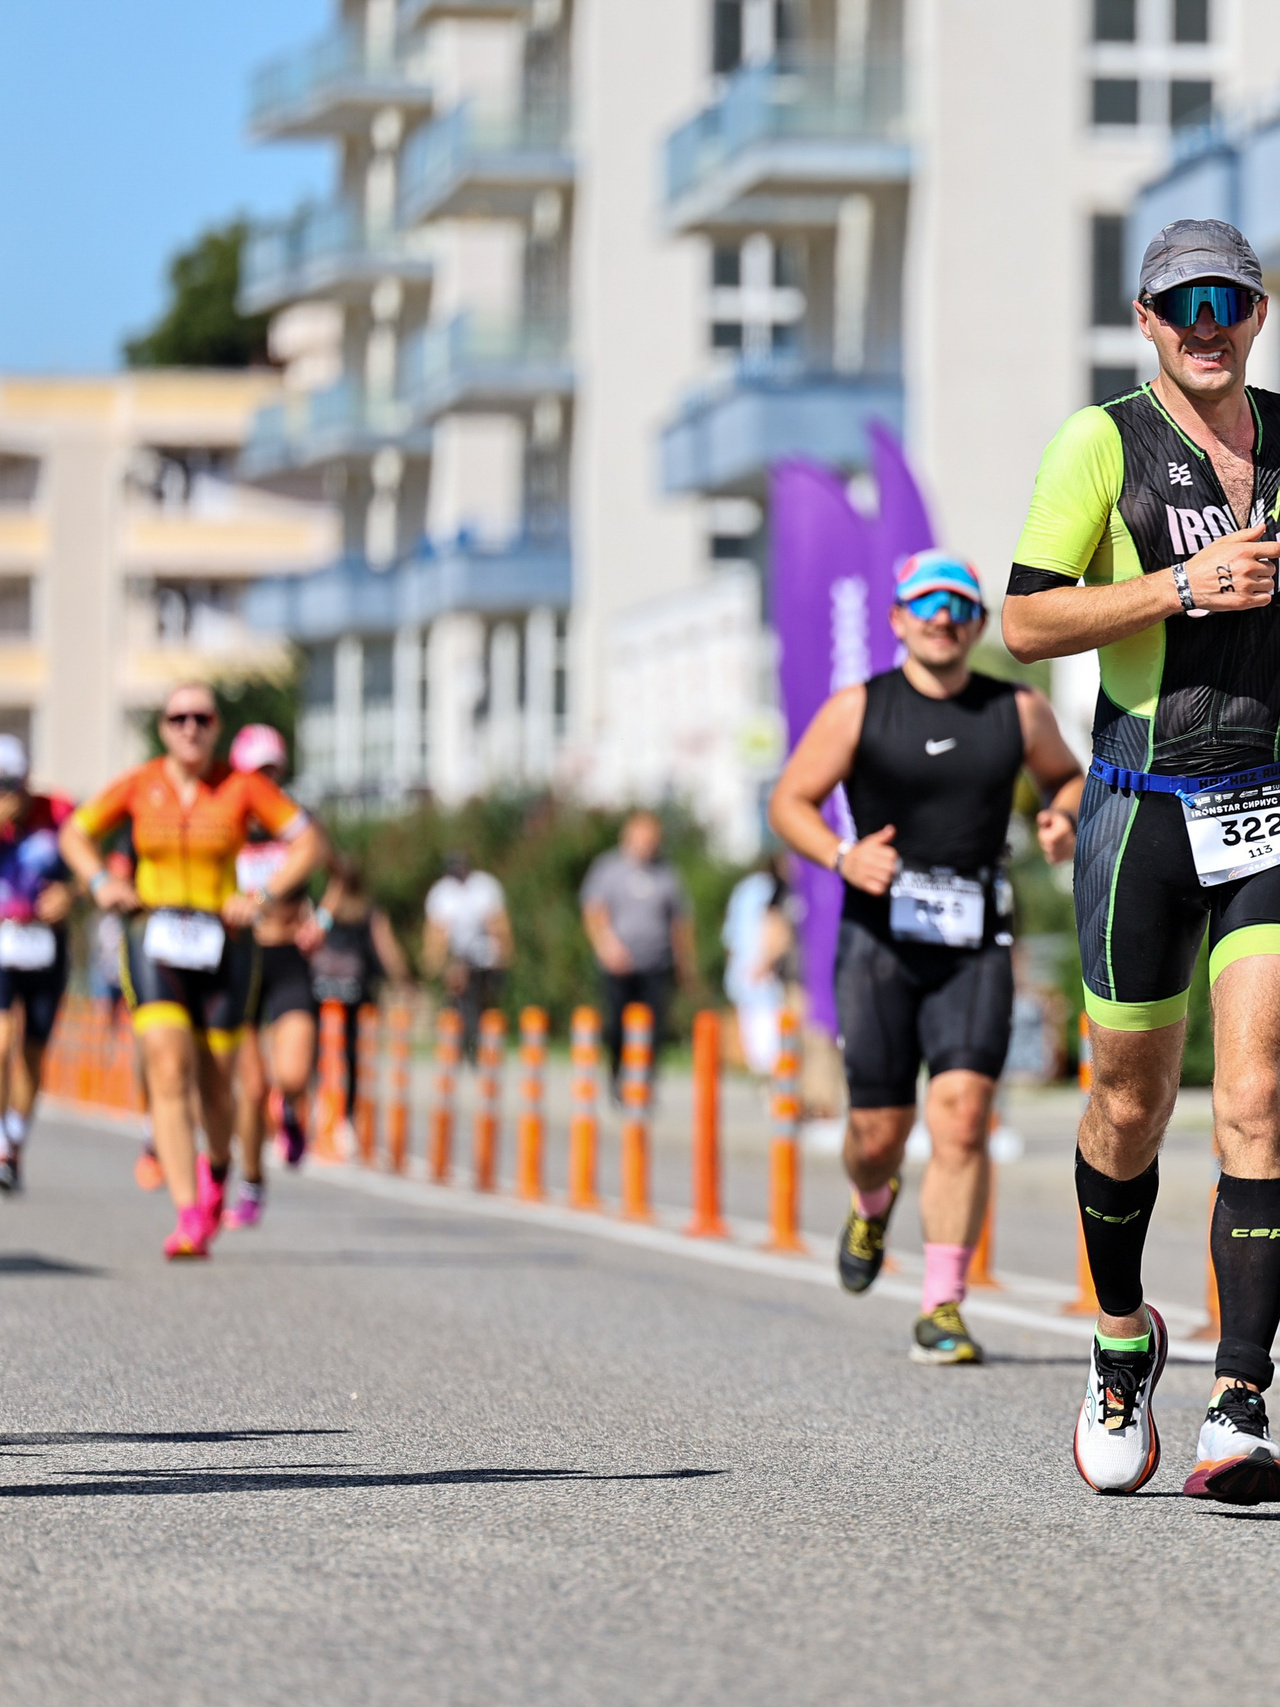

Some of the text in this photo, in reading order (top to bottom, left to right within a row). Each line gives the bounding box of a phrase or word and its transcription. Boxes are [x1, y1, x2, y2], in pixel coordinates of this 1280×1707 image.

[1216, 564, 1236, 594] 322
[1191, 803, 1240, 818] IRONSTAR
[1242, 798, 1278, 810] СИРИУС
[1248, 844, 1273, 859] 113
[1085, 1204, 1140, 1225] cep
